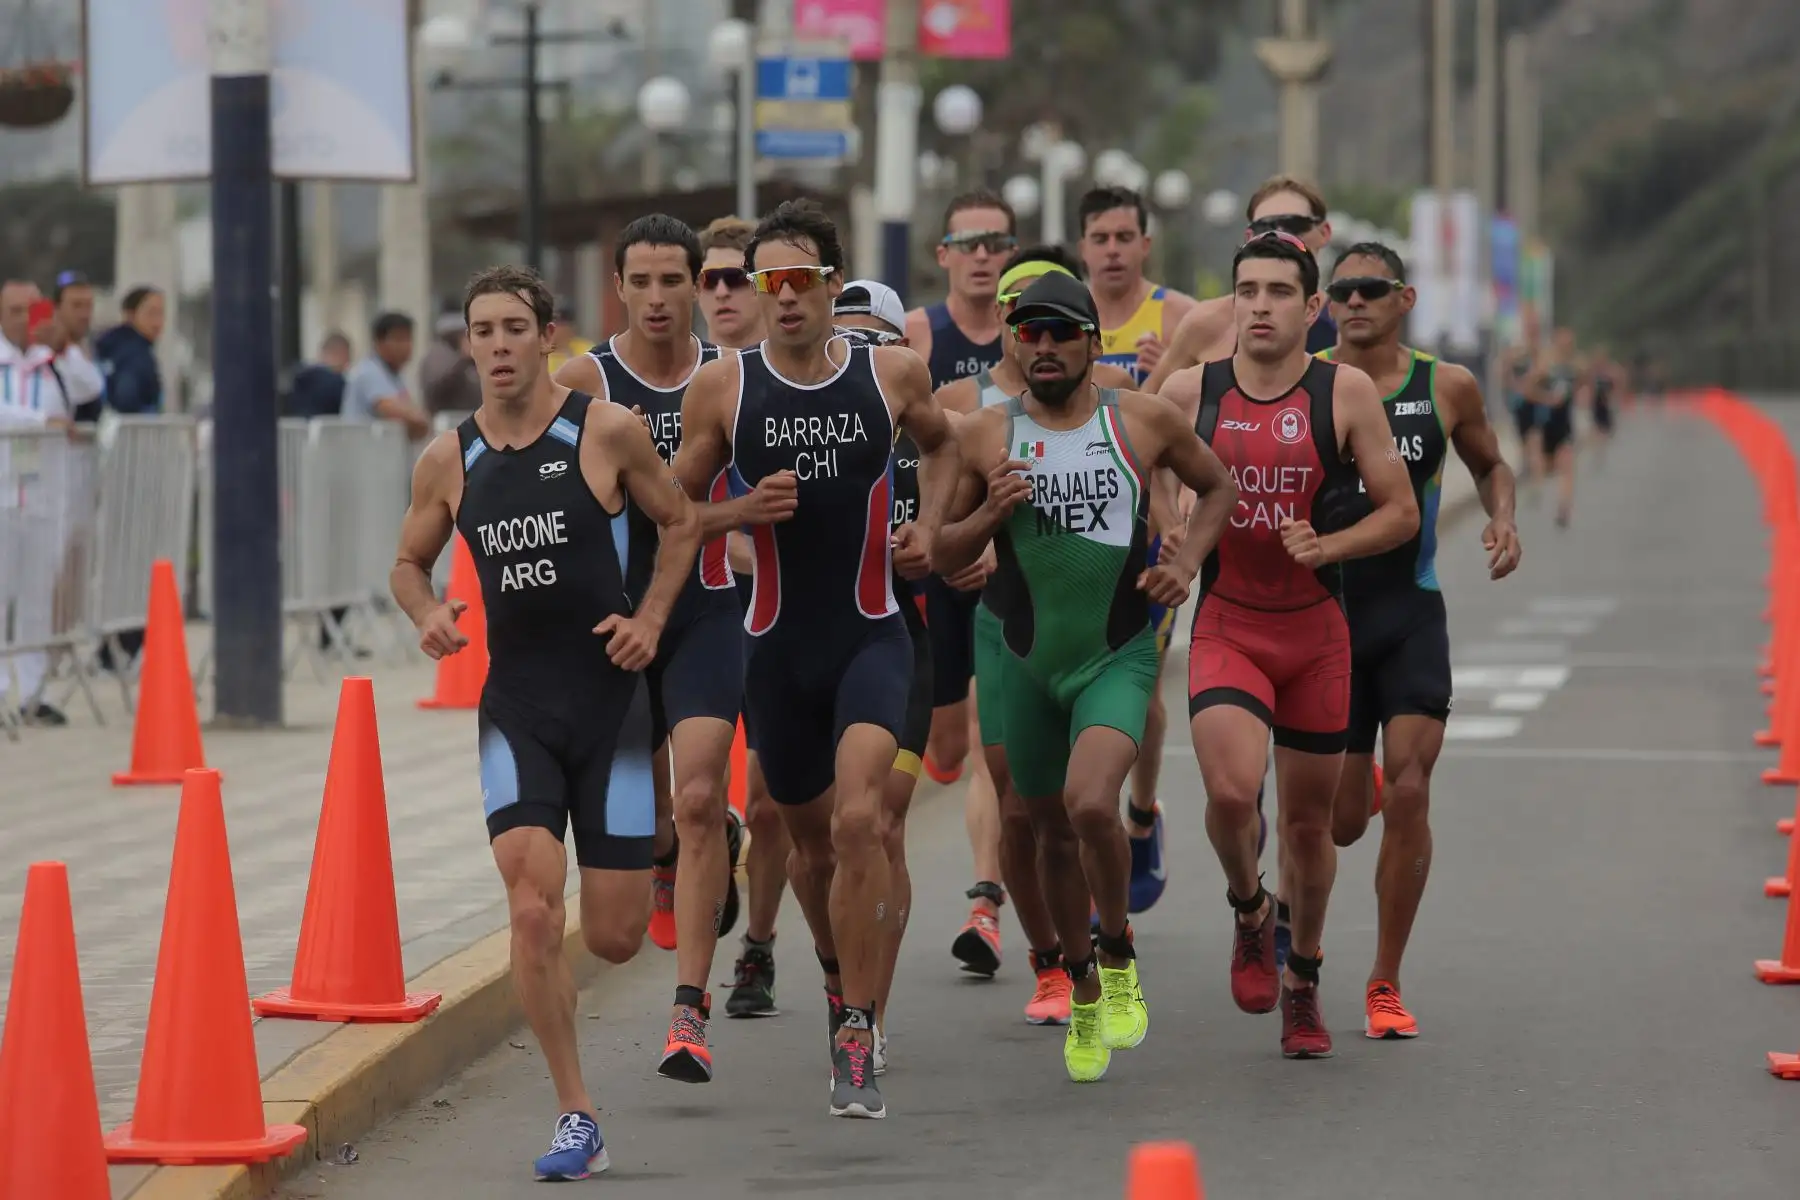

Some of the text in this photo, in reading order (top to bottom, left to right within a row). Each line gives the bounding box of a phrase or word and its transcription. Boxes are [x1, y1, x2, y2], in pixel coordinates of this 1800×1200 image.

[765, 412, 868, 447] BARRAZA
[1221, 420, 1260, 431] 2XU
[796, 448, 838, 480] CHI
[1229, 465, 1313, 494] AQUET
[1024, 468, 1119, 505] GRAJALES
[1036, 501, 1110, 536] MEX
[1230, 500, 1294, 530] CAN
[477, 511, 568, 556] TACCONE
[501, 559, 557, 592] ARG
